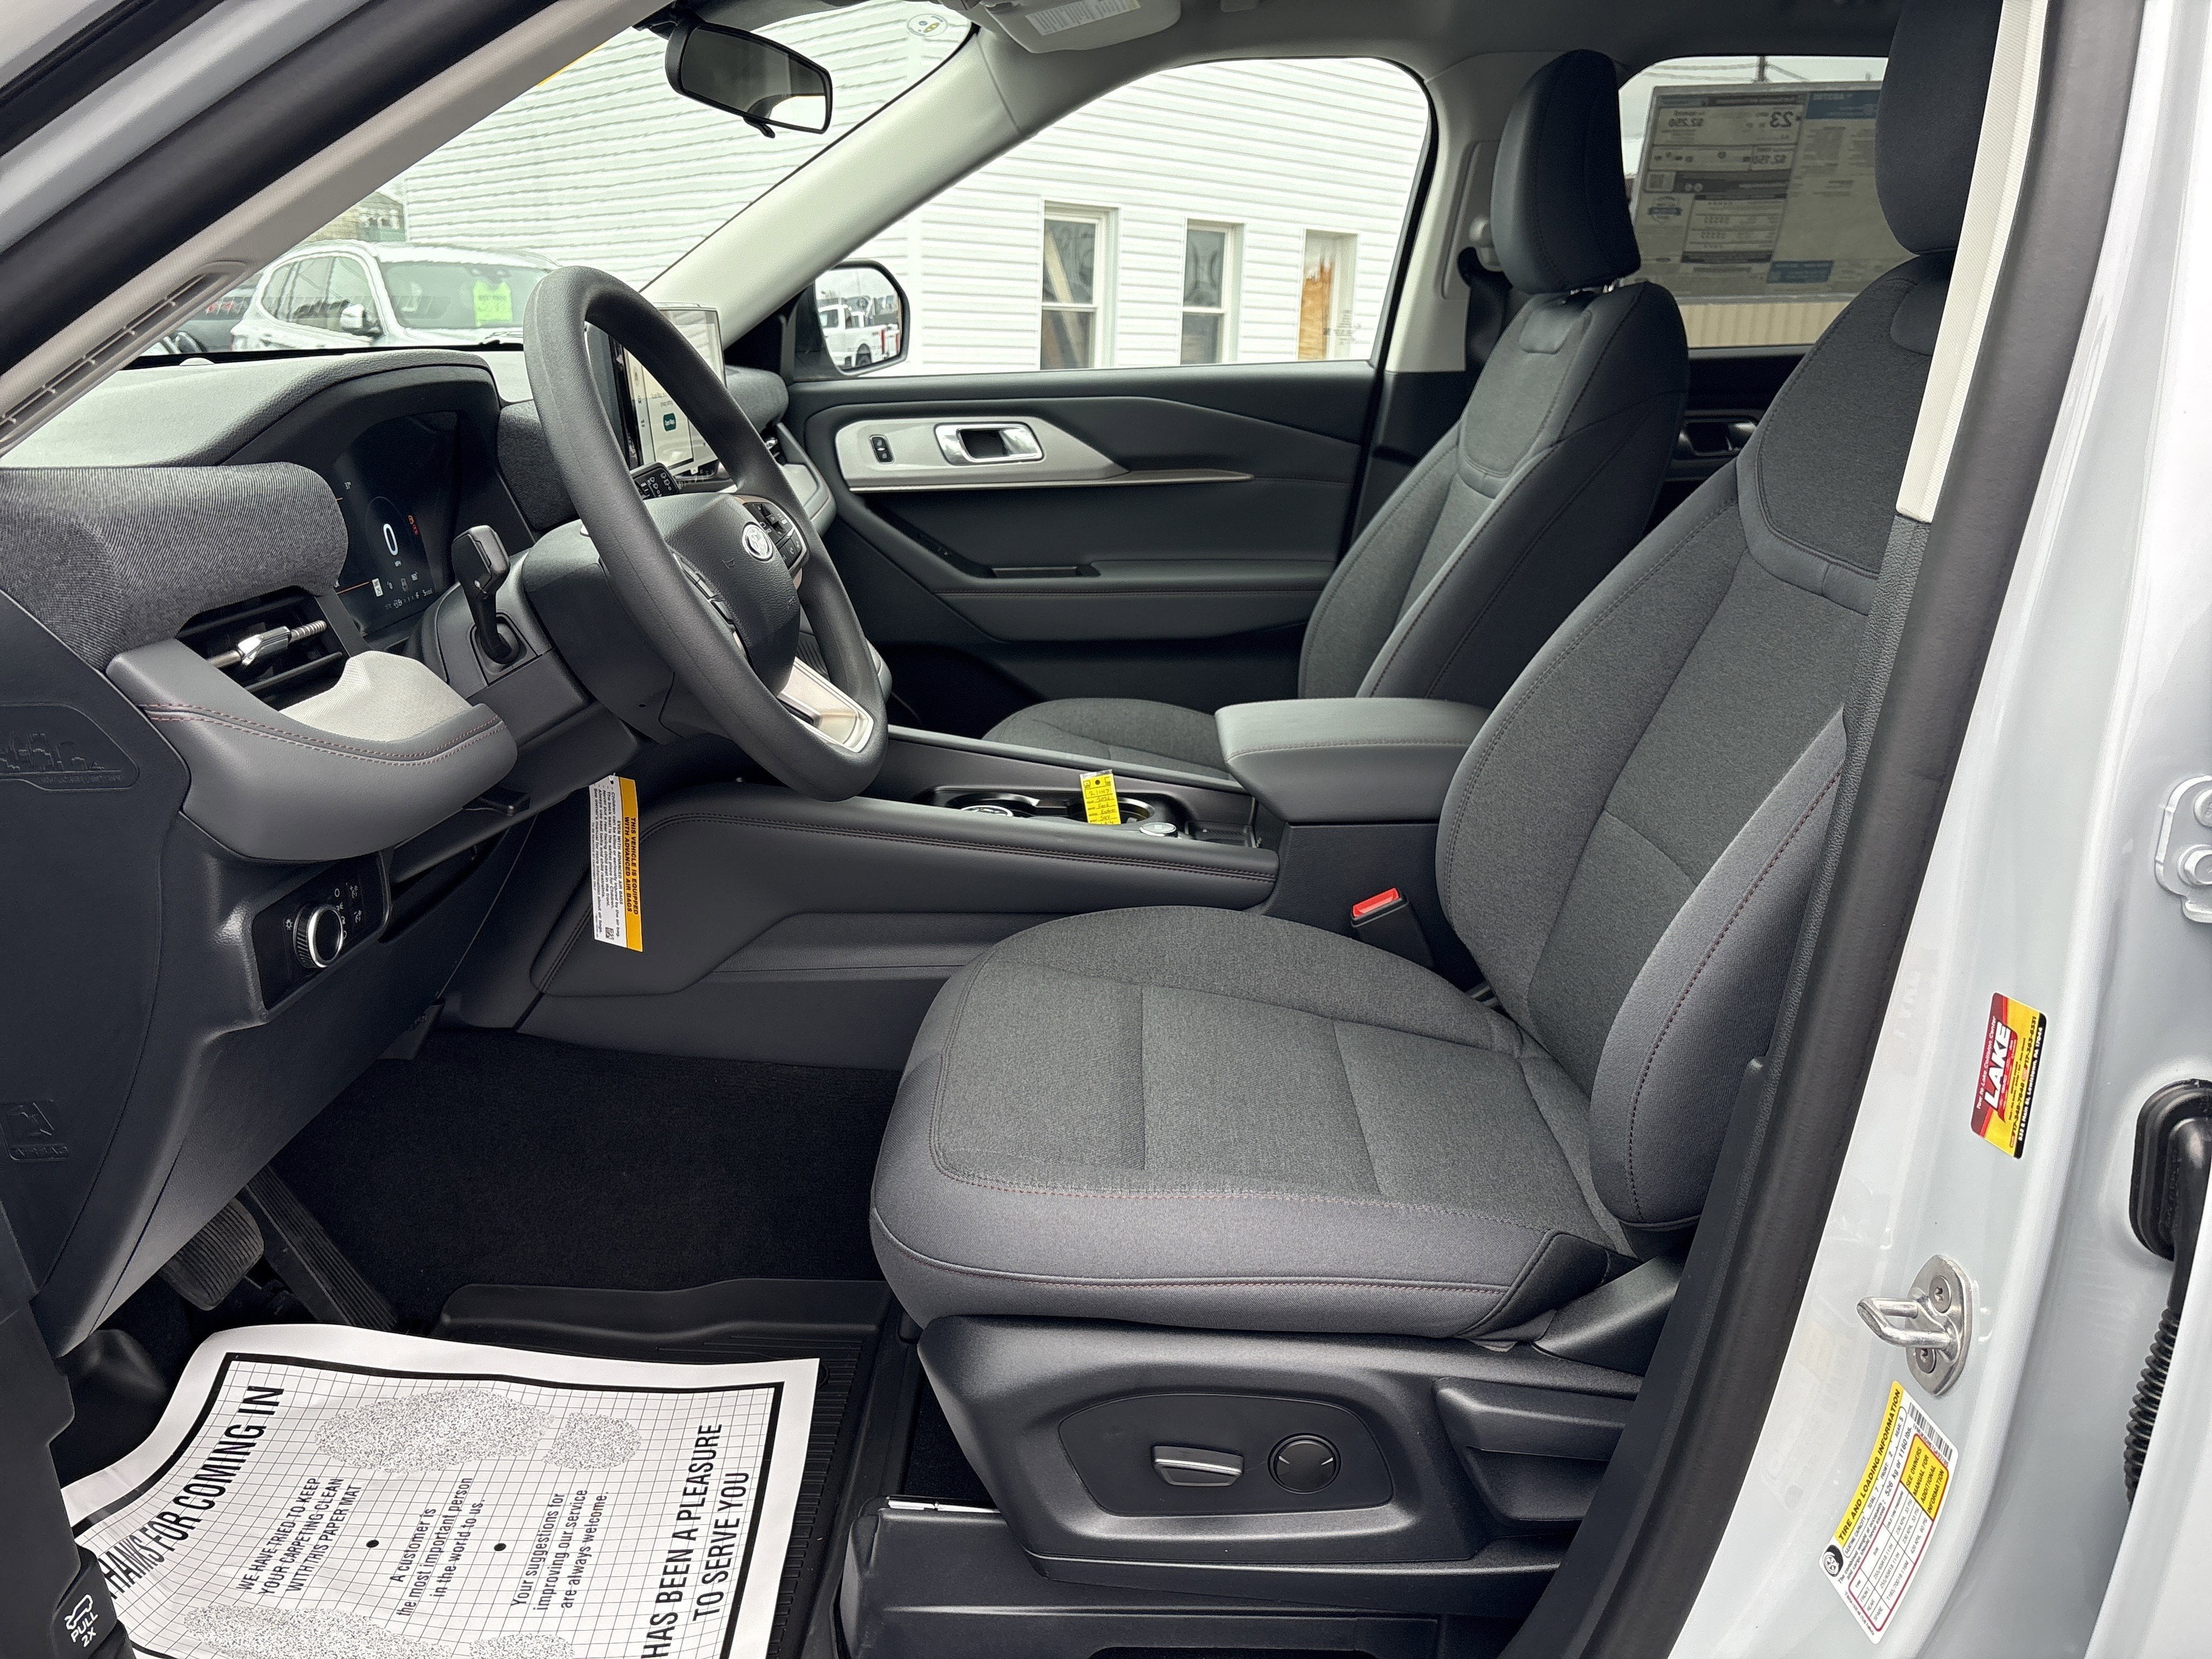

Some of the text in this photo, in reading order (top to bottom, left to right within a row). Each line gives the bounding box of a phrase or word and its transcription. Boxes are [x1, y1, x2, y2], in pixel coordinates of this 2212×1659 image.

[1983, 1040, 1993, 1069] Collision
[1984, 1022, 2011, 1109] LAKE
[1838, 1389, 1900, 1541] TIRE AND LOADING INFORMATION
[1896, 1459, 1901, 1469] or
[1898, 1438, 1908, 1458] 1160
[1910, 1446, 1922, 1475] OWNERS
[97, 1385, 284, 1600] HANKS FOR COMING IN
[1884, 1480, 1893, 1497] 526
[1891, 1469, 1899, 1480] kg
[1912, 1454, 1929, 1497] MANUAL FOR
[1920, 1465, 1937, 1504] ADDITIONAL
[1927, 1469, 1944, 1514] INFORMATION
[236, 1478, 320, 1590] WE HAVE TRIED TO KEEP
[1844, 1537, 1856, 1555] SEATING
[1854, 1515, 1866, 1537] CAPACITY
[1869, 1524, 1877, 1539] never
[1876, 1505, 1886, 1525] exceed
[259, 1479, 343, 1594] YOUR CARPETING CLEAN
[286, 1485, 361, 1592] WITH THIS PAPER MAT
[397, 1521, 429, 1571] customer
[419, 1506, 437, 1519] is
[397, 1479, 472, 1616] the most important person
[435, 1497, 485, 1597] in the world to us.
[511, 1494, 563, 1606] Your suggestions for
[538, 1490, 588, 1610] improving our service
[561, 1495, 607, 1608] are always welcome.
[641, 1424, 722, 1658] HAS BEEN A PLEASURE
[693, 1472, 749, 1621] TO SERVE YOU
[1844, 1550, 1859, 1575] combined
[1857, 1533, 1867, 1551] weight
[1869, 1502, 1883, 1528] occupants
[1860, 1538, 1870, 1556] should
[1852, 1555, 1861, 1570] cargo
[1860, 1587, 1870, 1602] FRONT
[1866, 1599, 1875, 1612] REAR
[1873, 1605, 1883, 1621] SPARE
[71, 1612, 99, 1643] PULL
[81, 1627, 97, 1647] 2X
